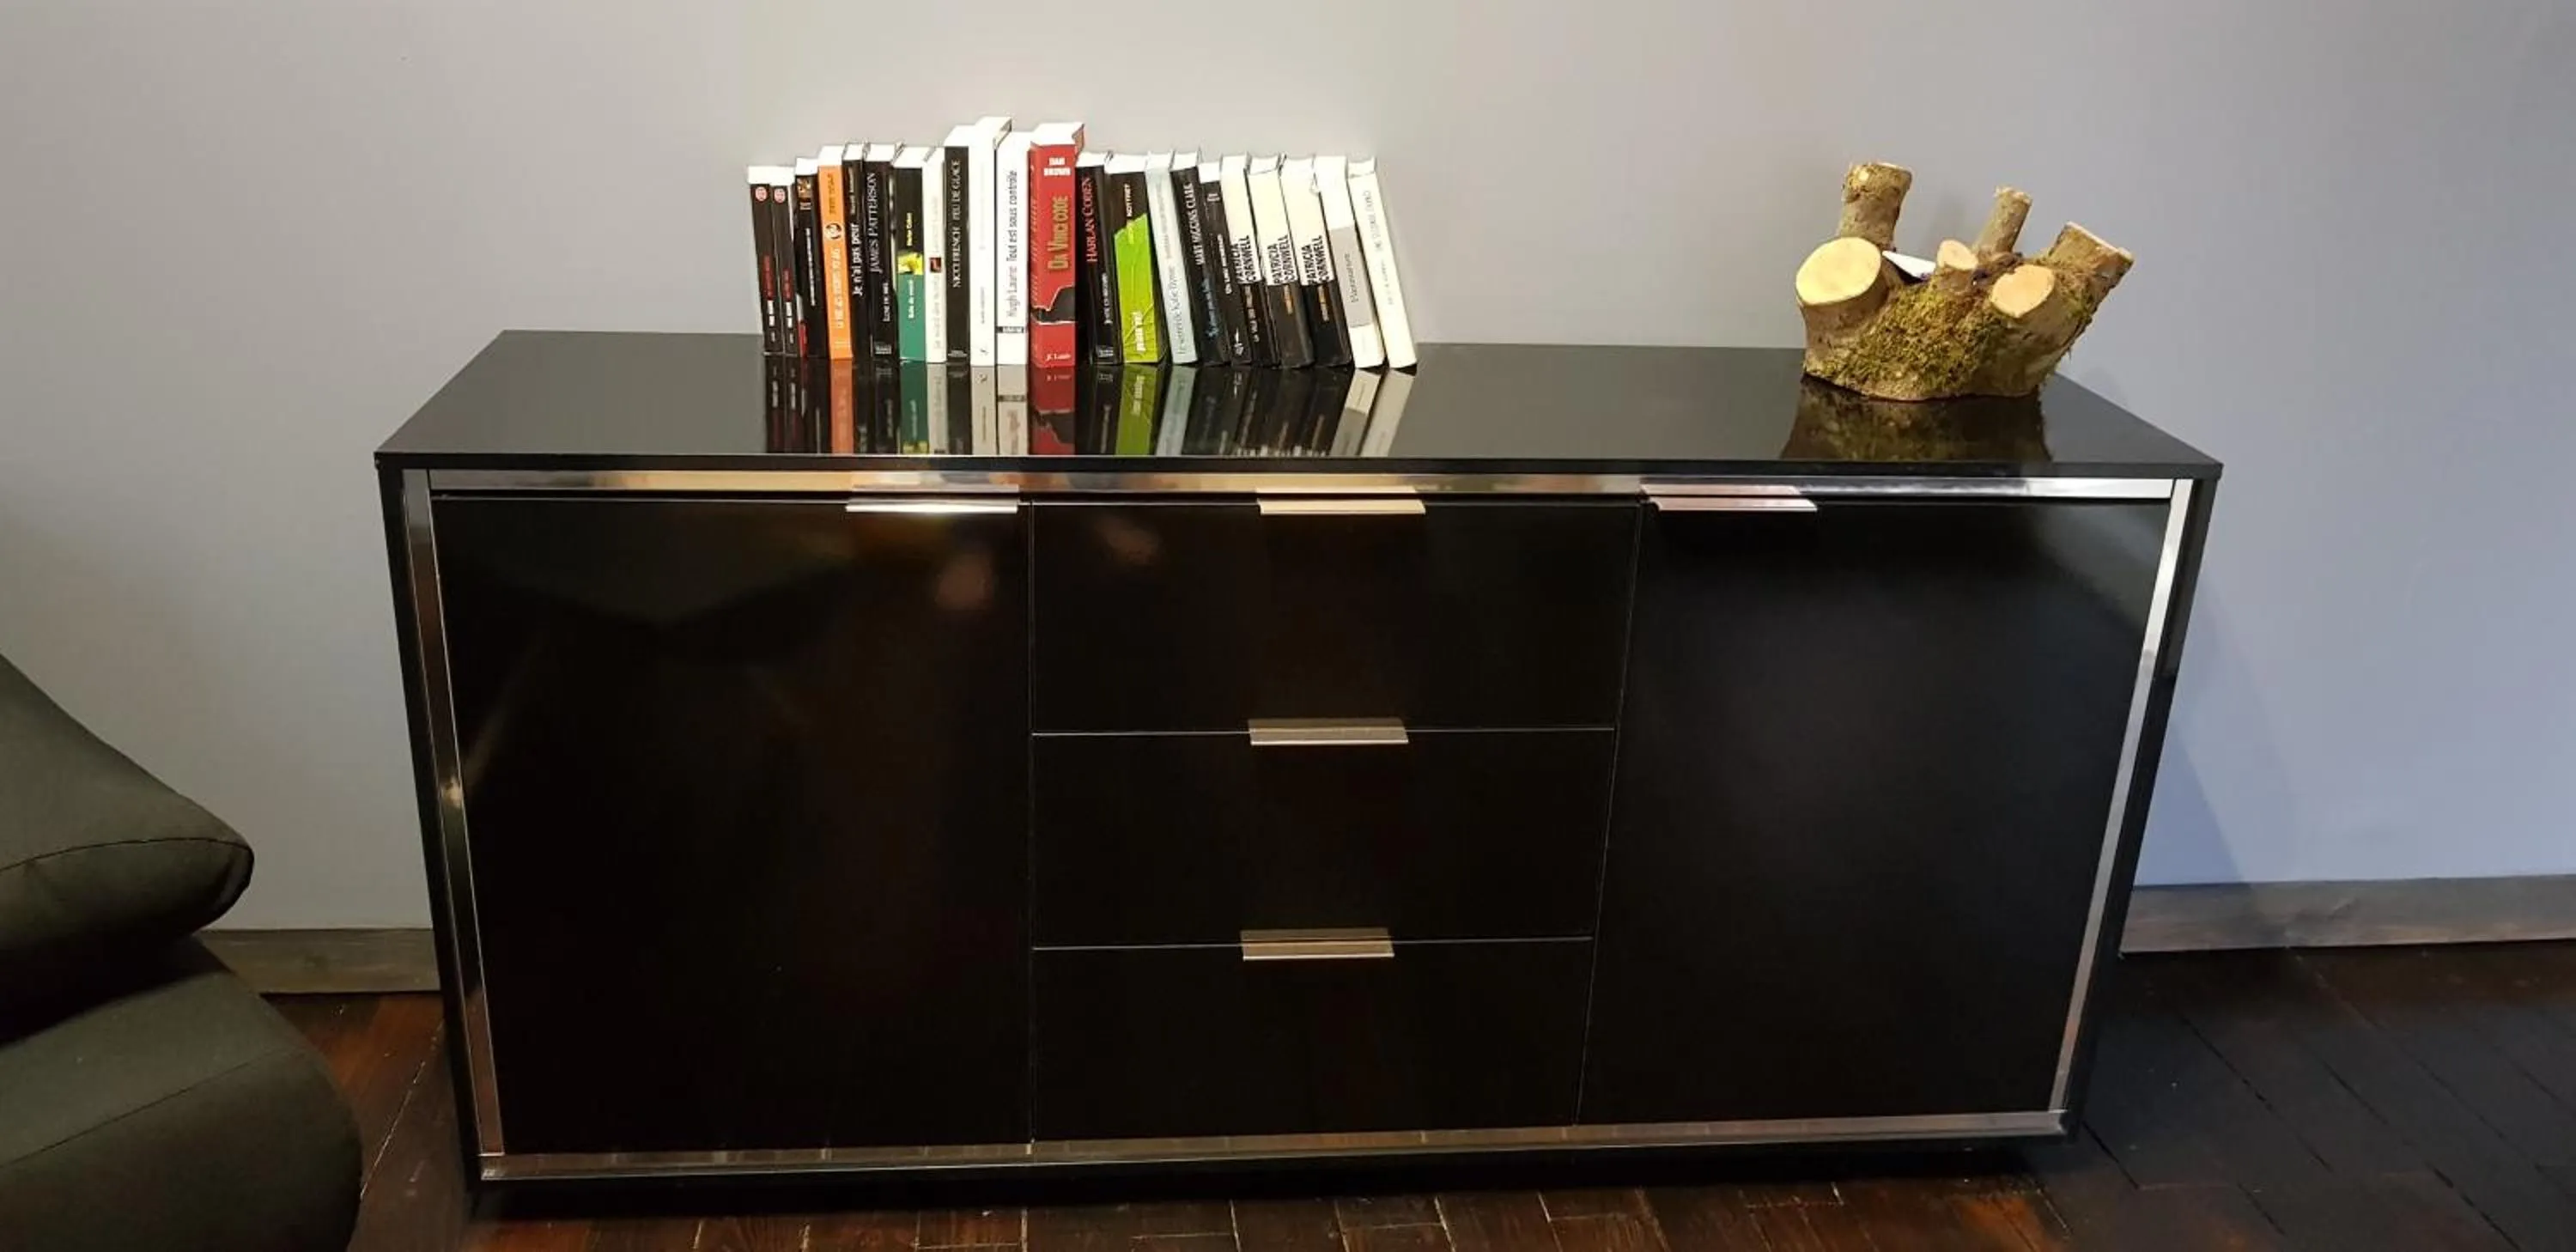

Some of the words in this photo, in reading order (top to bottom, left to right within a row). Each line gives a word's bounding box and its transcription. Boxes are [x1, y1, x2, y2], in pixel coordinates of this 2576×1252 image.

[866, 173, 878, 237] PATTERSON
[1185, 182, 1195, 209] CLARK
[850, 222, 861, 245] peur
[1009, 207, 1018, 228] sous
[1189, 209, 1202, 243] HIGGINS
[1006, 244, 1018, 263] Tout
[1007, 229, 1017, 244] est
[1084, 218, 1098, 263] HARLAN
[851, 246, 862, 264] pas
[869, 239, 883, 274] JAMES
[1239, 234, 1257, 283] CORNWELL
[1268, 243, 1283, 284] PATRICIA
[1279, 234, 1296, 283] CORNWELL
[1302, 244, 1318, 285] PATRICIA
[1313, 234, 1330, 283] CORNWELL
